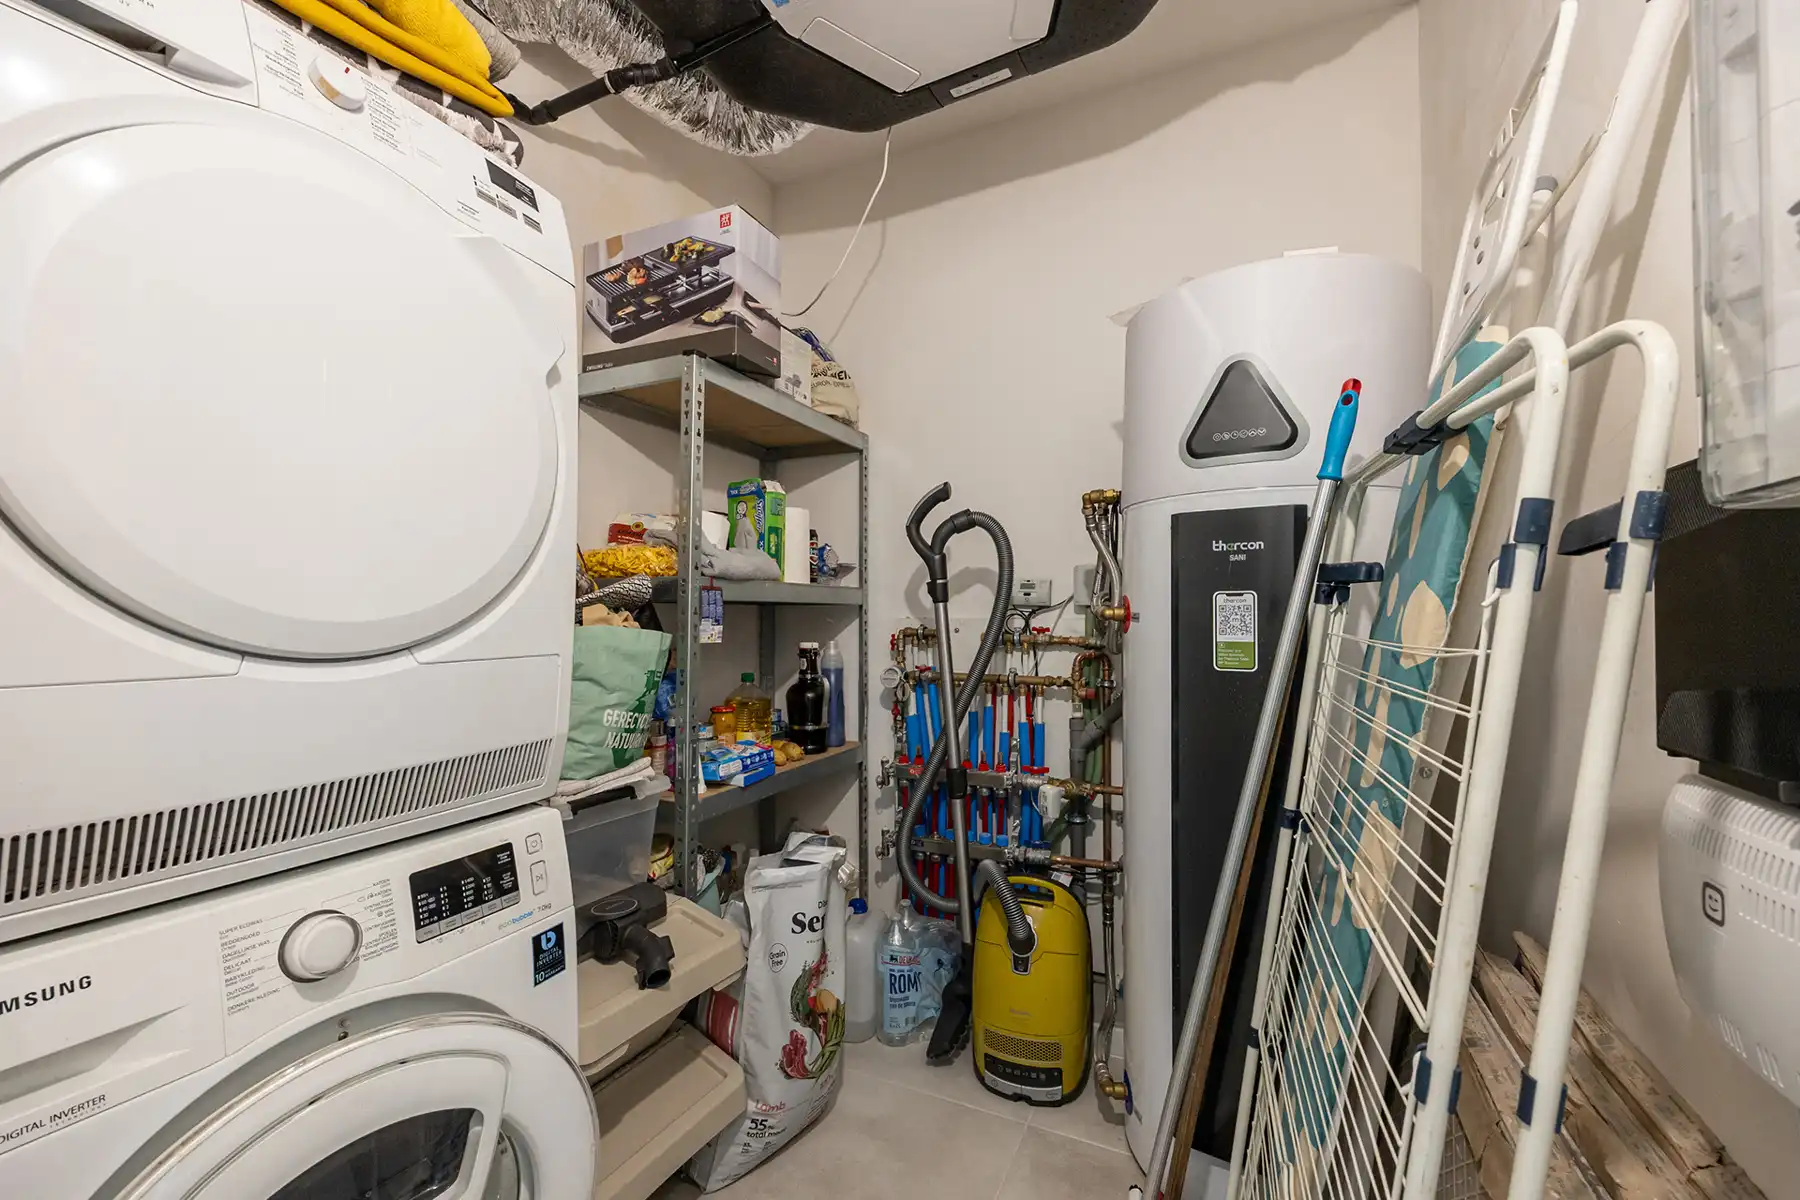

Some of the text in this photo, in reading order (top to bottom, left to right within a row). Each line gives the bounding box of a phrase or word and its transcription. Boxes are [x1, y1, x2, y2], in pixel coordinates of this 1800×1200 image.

[1229, 554, 1247, 562] SANI
[536, 949, 562, 967] INVERTER
[539, 946, 559, 960] DIGITAL
[770, 949, 786, 960] Grain
[772, 959, 784, 968] Free
[535, 971, 545, 983] 10
[226, 982, 255, 997] OUTDOOR
[755, 1100, 786, 1112] Lamb
[0, 1094, 106, 1145] DIGITAL INVERTER
[747, 1130, 766, 1139] total
